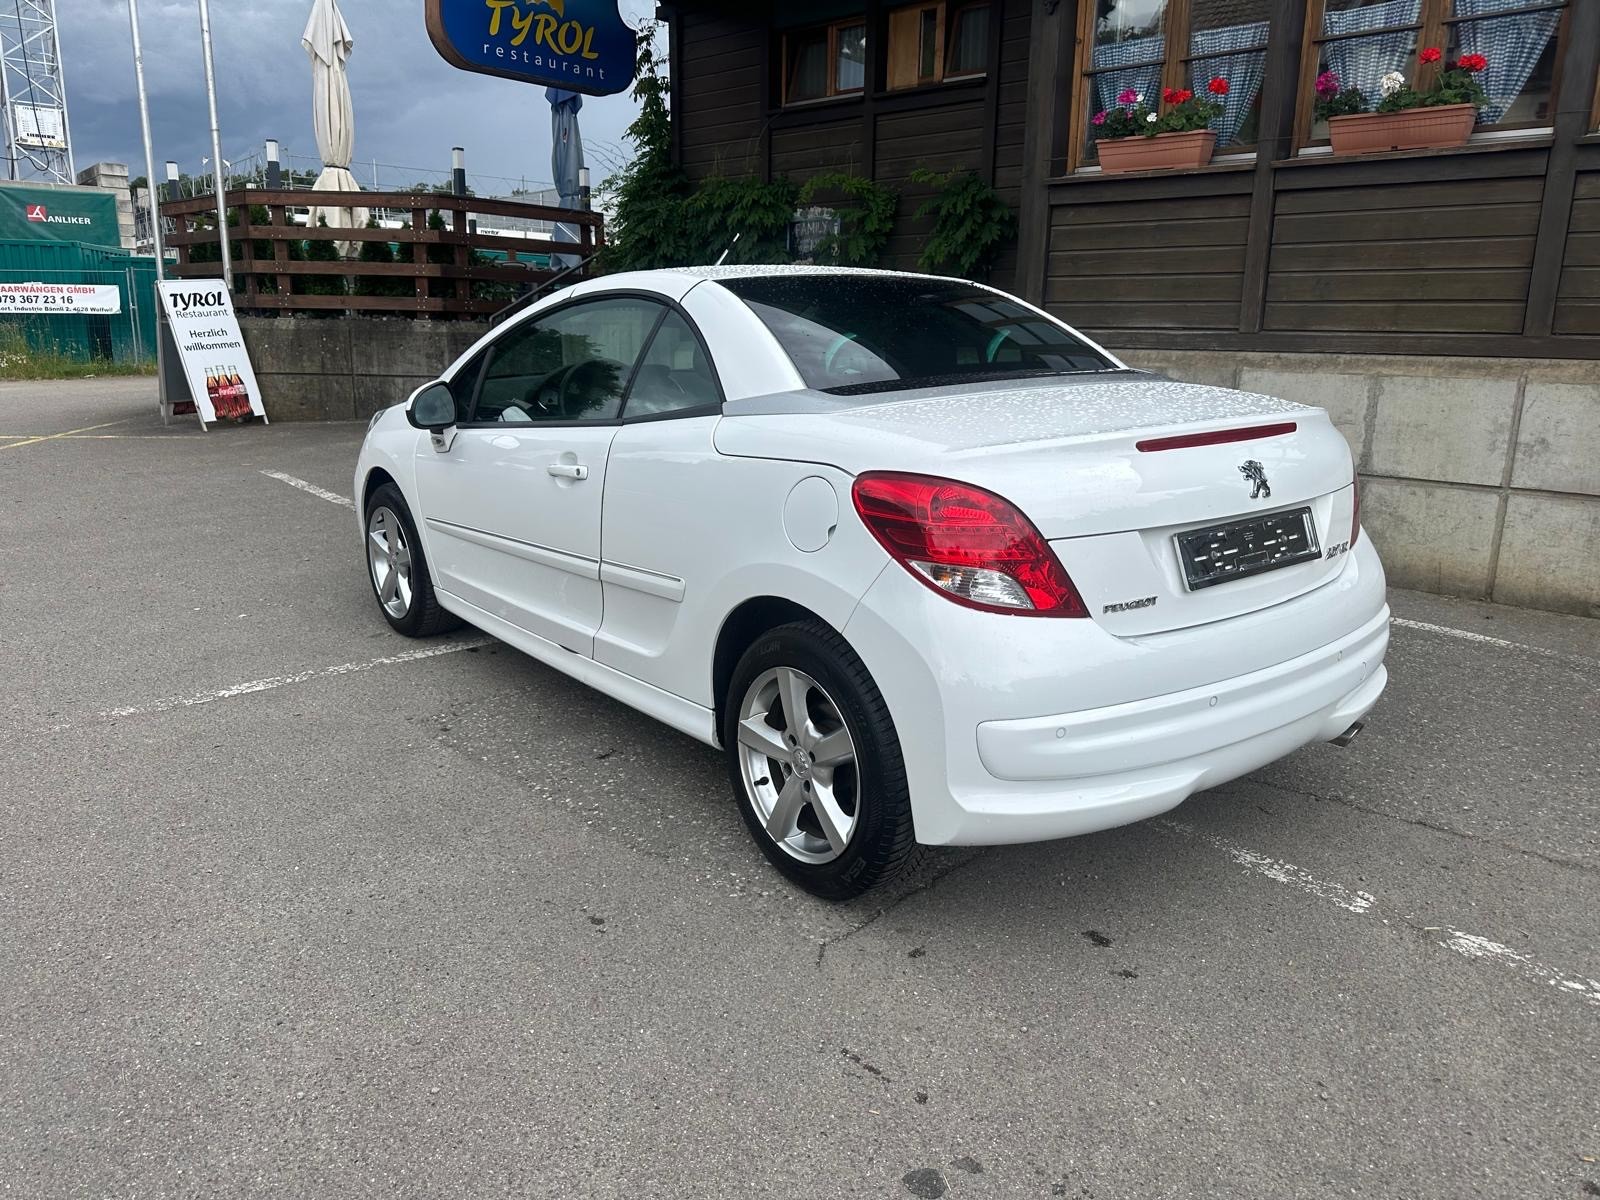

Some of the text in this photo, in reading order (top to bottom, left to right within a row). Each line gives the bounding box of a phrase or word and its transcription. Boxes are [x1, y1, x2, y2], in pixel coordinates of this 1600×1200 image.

[485, 0, 599, 59] TYROL
[483, 43, 605, 80] restaurant
[48, 215, 92, 225] ANLIKER
[0, 295, 74, 304] 79 367 23 16
[169, 291, 225, 311] TYROL
[175, 308, 229, 319] Restaurant
[189, 328, 228, 339] Herzlich
[183, 341, 241, 352] willkommen
[1102, 595, 1159, 614] PEUGEOT
